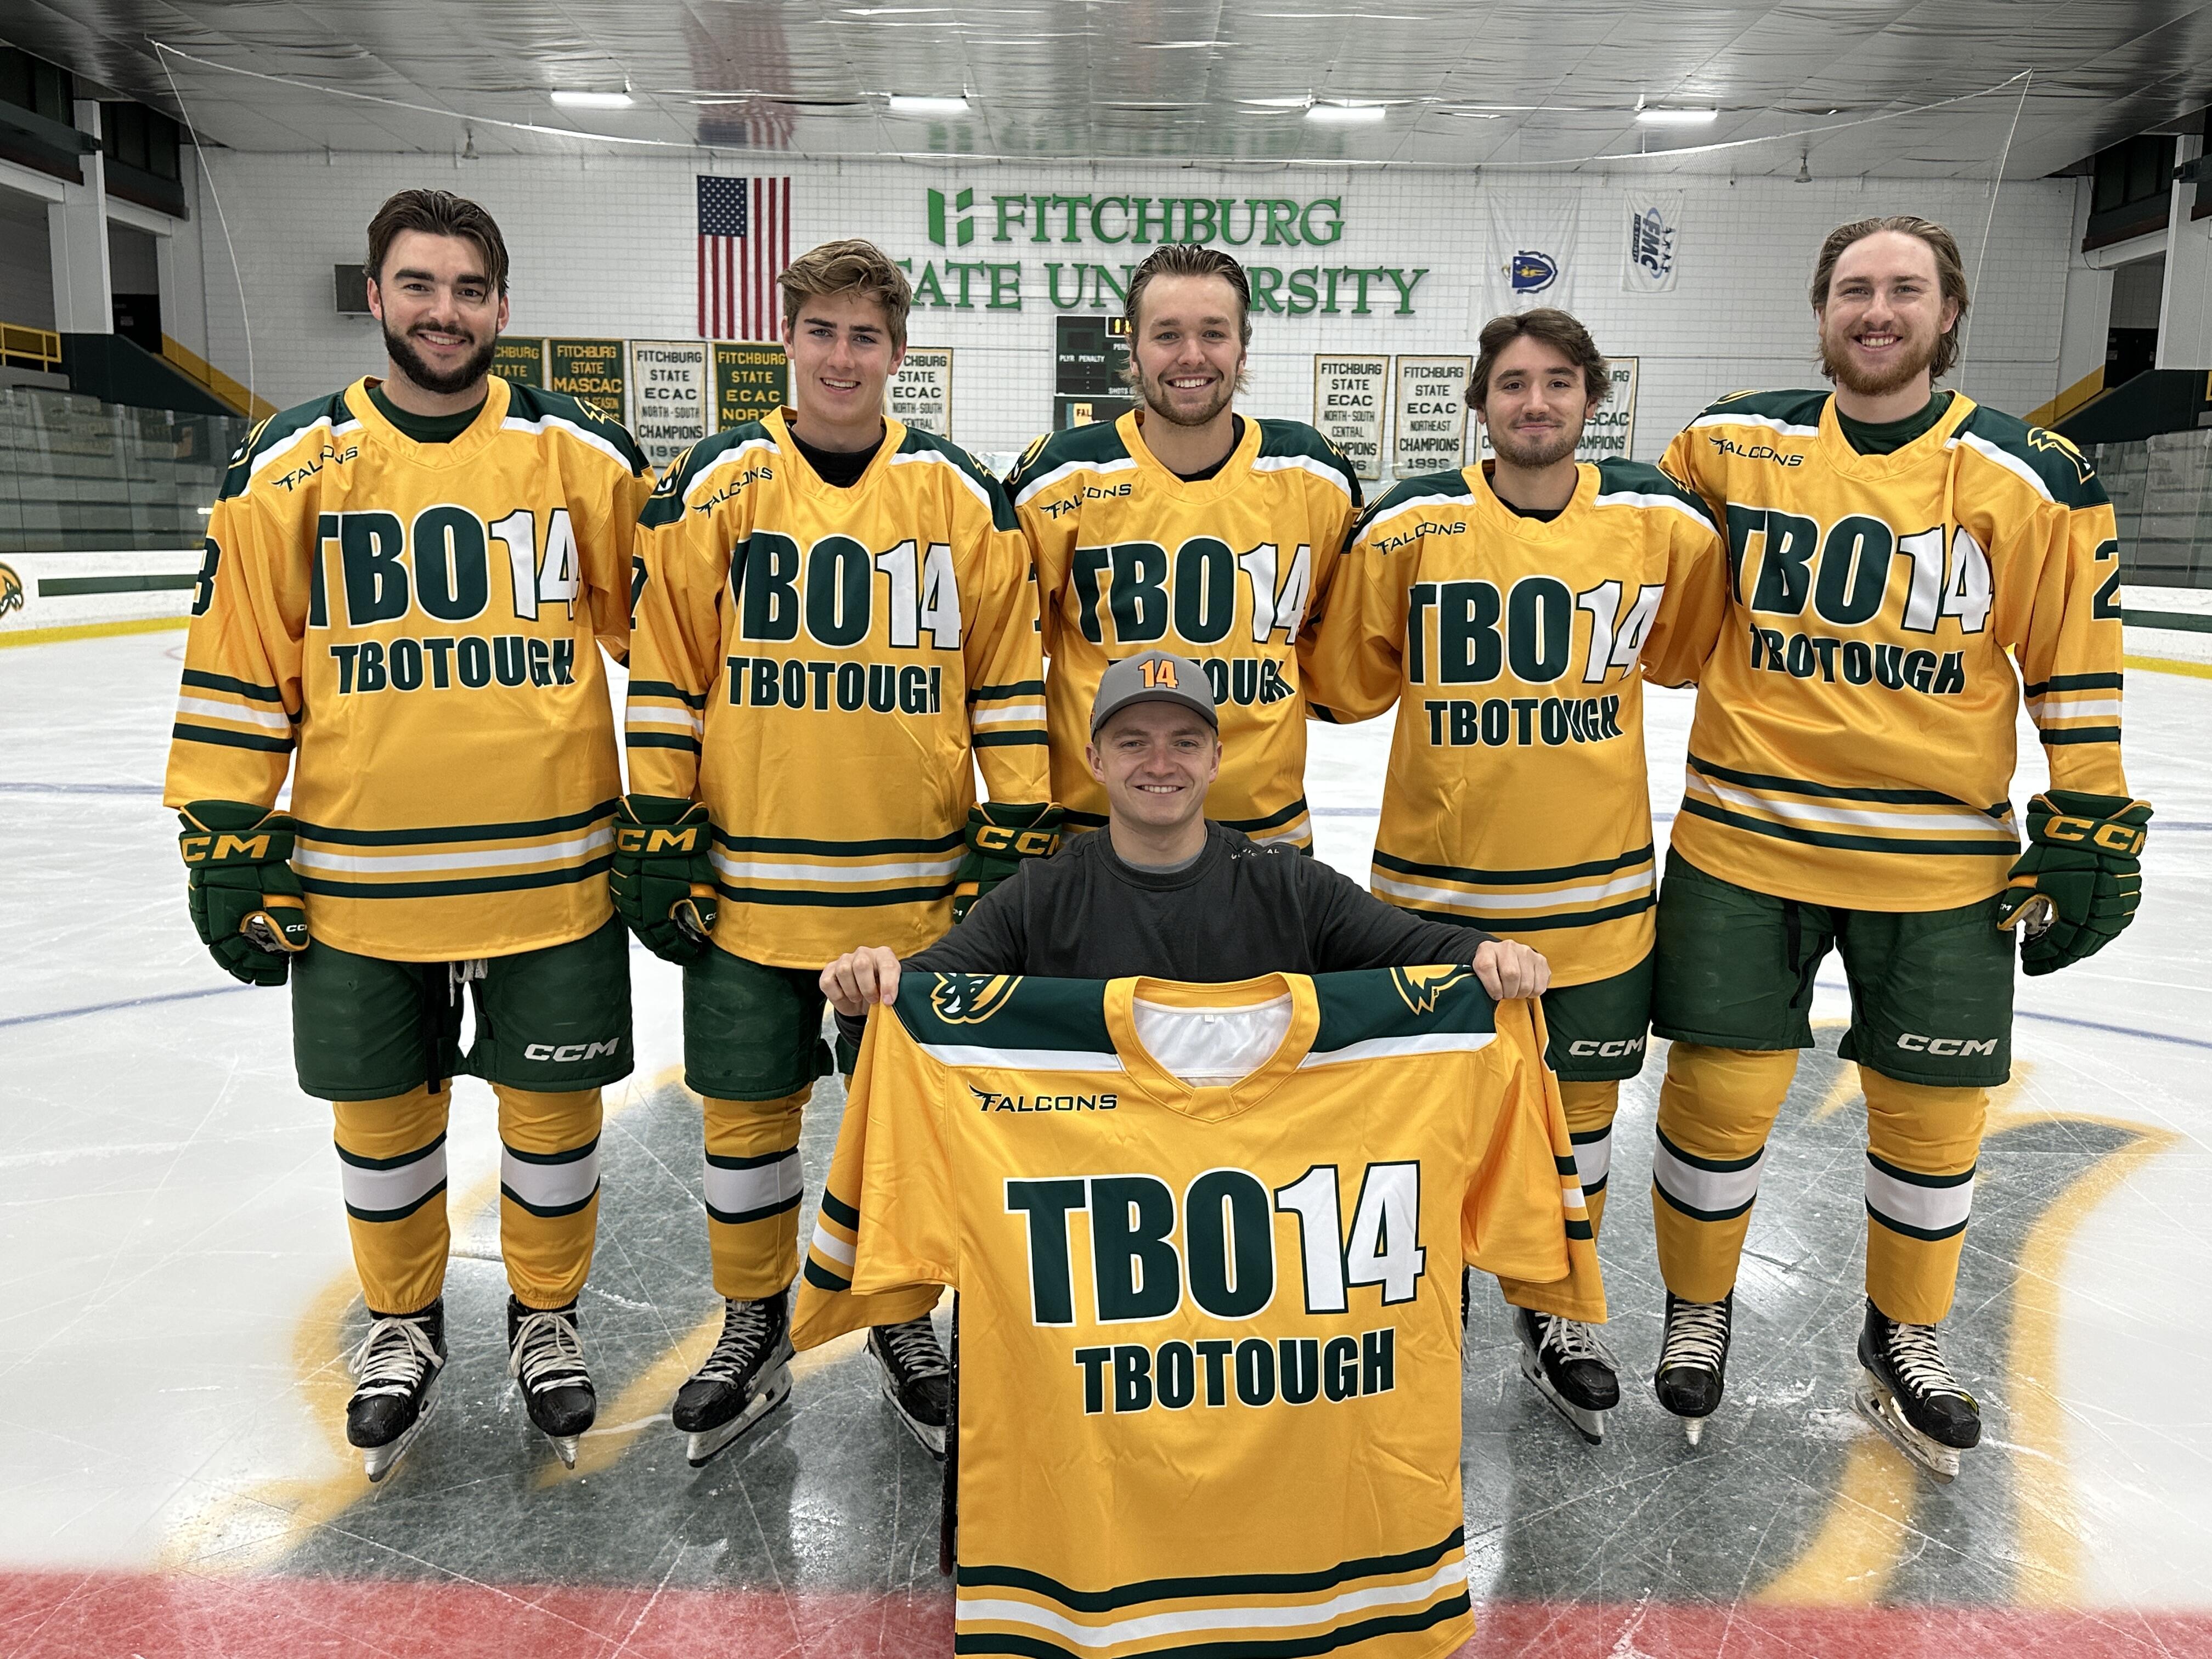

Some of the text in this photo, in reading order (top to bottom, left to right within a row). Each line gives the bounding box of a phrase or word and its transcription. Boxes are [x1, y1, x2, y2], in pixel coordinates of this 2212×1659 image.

[991, 194, 1346, 247] FITCHBURG
[1641, 218, 1660, 271] FMC
[898, 257, 1430, 315] ATE UNRSITY
[494, 346, 540, 360] CHBURG
[557, 345, 617, 359] FITCHBURG
[637, 350, 702, 363] FITCHBURG
[718, 351, 787, 365] FITCHBURG
[571, 362, 605, 374] STATE
[904, 356, 947, 367] CHBURG
[650, 370, 690, 382] STATE
[1321, 363, 1383, 375] FITCHBURG
[1404, 366, 1464, 379] FITCHBURG
[732, 370, 774, 383] STATE
[898, 371, 935, 383] STATE
[554, 376, 623, 393] MASCAC
[1331, 379, 1370, 391] STATE
[1415, 385, 1450, 397] STATE
[645, 387, 697, 400] ECAC
[726, 389, 781, 403] ECAC
[893, 387, 942, 398] ECAC
[1327, 394, 1373, 406] ECAC
[723, 408, 772, 420] NORT
[1407, 403, 1457, 414] ECAC
[901, 417, 934, 430] CENTRAL
[1410, 420, 1451, 432] NORTHEAST
[639, 425, 703, 439] CHAMPIONS
[1332, 426, 1364, 438] CENTRAL
[650, 446, 680, 458] 199
[1399, 438, 1459, 452] CHAMPIONS
[1708, 437, 1804, 467] FALCONS
[272, 445, 358, 492] FALCONS
[692, 466, 774, 518] FALCONS
[1040, 483, 1132, 520] FALCONS
[1370, 522, 1466, 556] FALCONS
[330, 635, 576, 696] TBOTOUGH
[1138, 659, 1179, 689] 14
[1424, 694, 1625, 748] TBOTOUGH
[617, 827, 698, 852] CM
[182, 834, 271, 862] CM
[524, 1037, 619, 1062] CCM
[1568, 1035, 1645, 1057] CCM
[1896, 1032, 1999, 1057] CCM
[968, 1081, 1118, 1113] FALCONS
[1003, 1159, 1426, 1328] TBO14
[1074, 1325, 1396, 1417] TBOTOUGH
